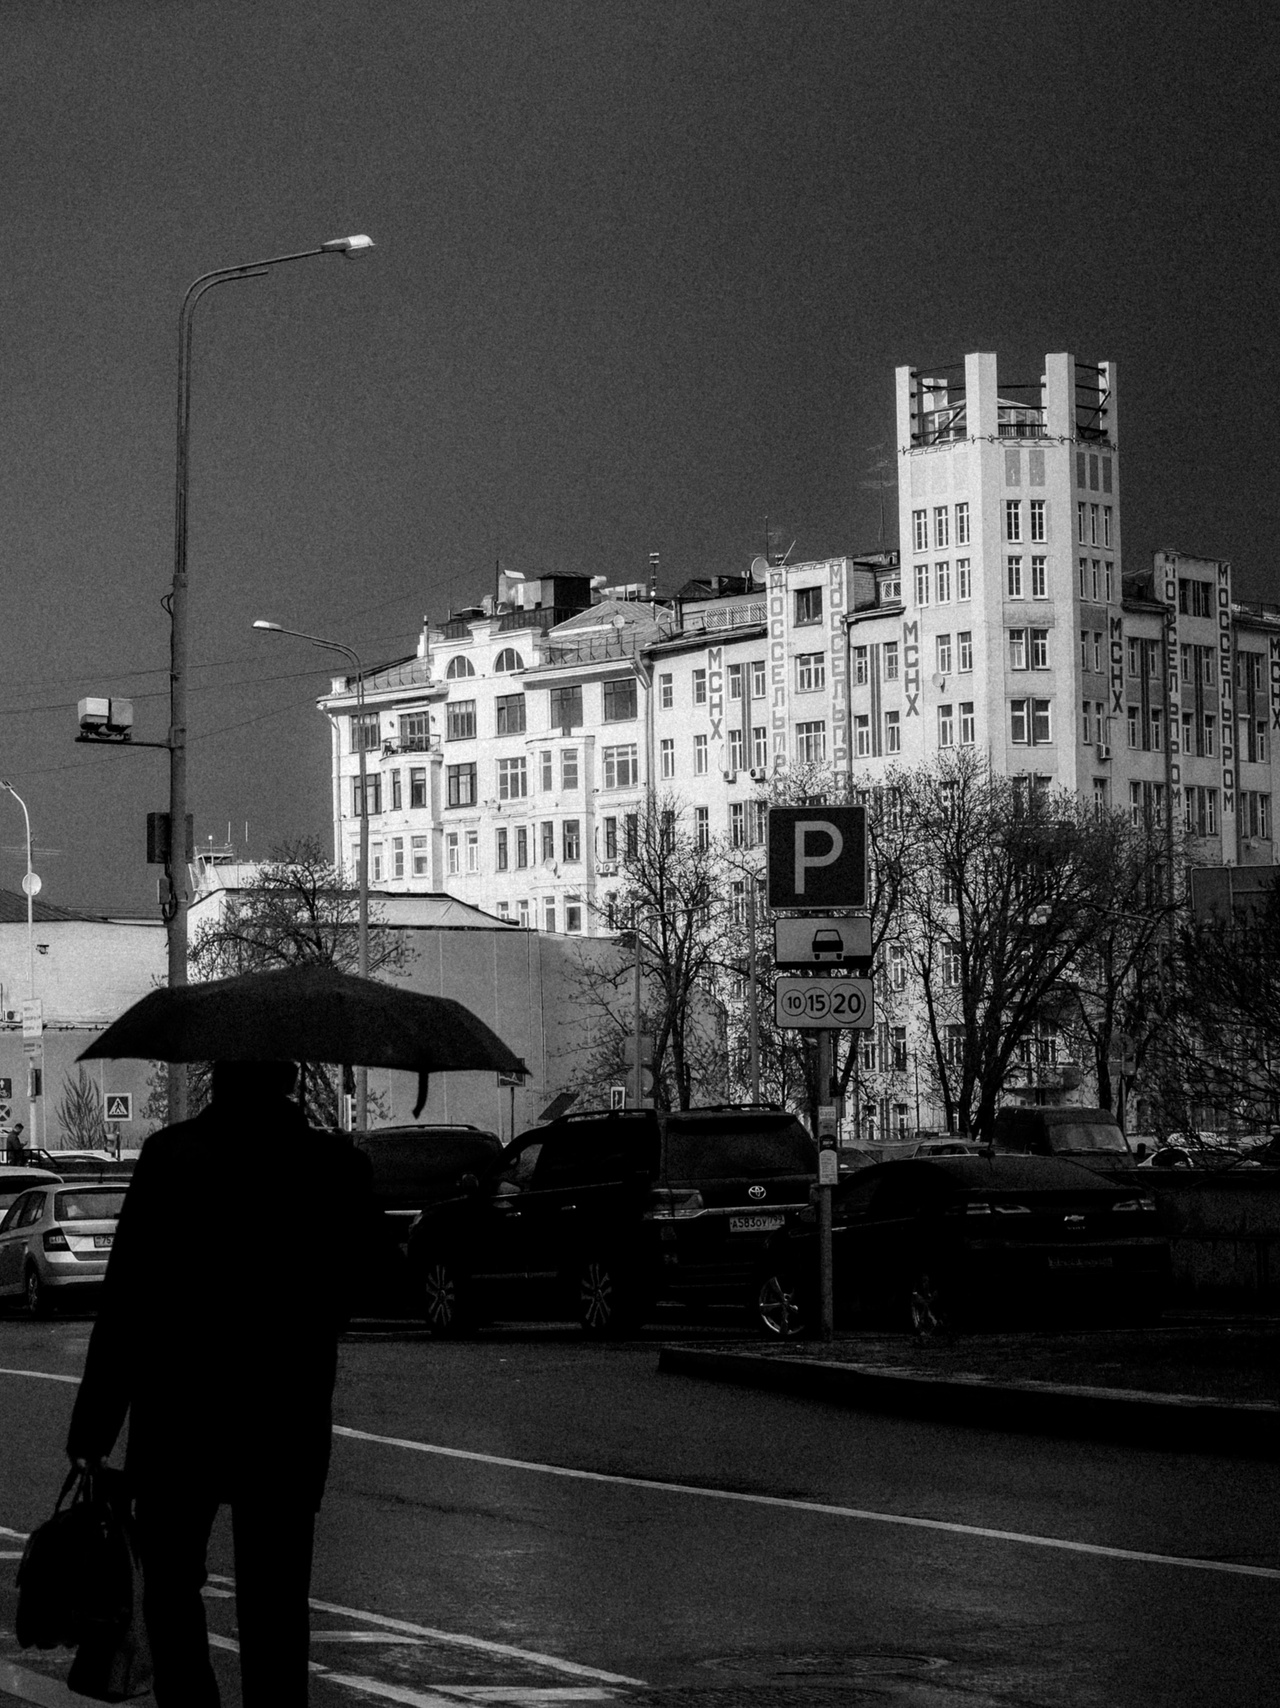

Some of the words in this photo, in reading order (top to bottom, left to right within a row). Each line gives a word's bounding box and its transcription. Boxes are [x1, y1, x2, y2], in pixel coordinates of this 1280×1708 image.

[707, 647, 723, 741] МСНХ
[829, 563, 848, 804] МОССЕЛЬПРО
[902, 620, 920, 718] МСНХ
[1109, 616, 1124, 713] МСНХ
[1217, 563, 1235, 813] МОССЕЛЬПРОМ
[794, 820, 844, 895] P
[787, 996, 802, 1010] 10
[807, 994, 826, 1012] 15
[833, 993, 861, 1014] 20
